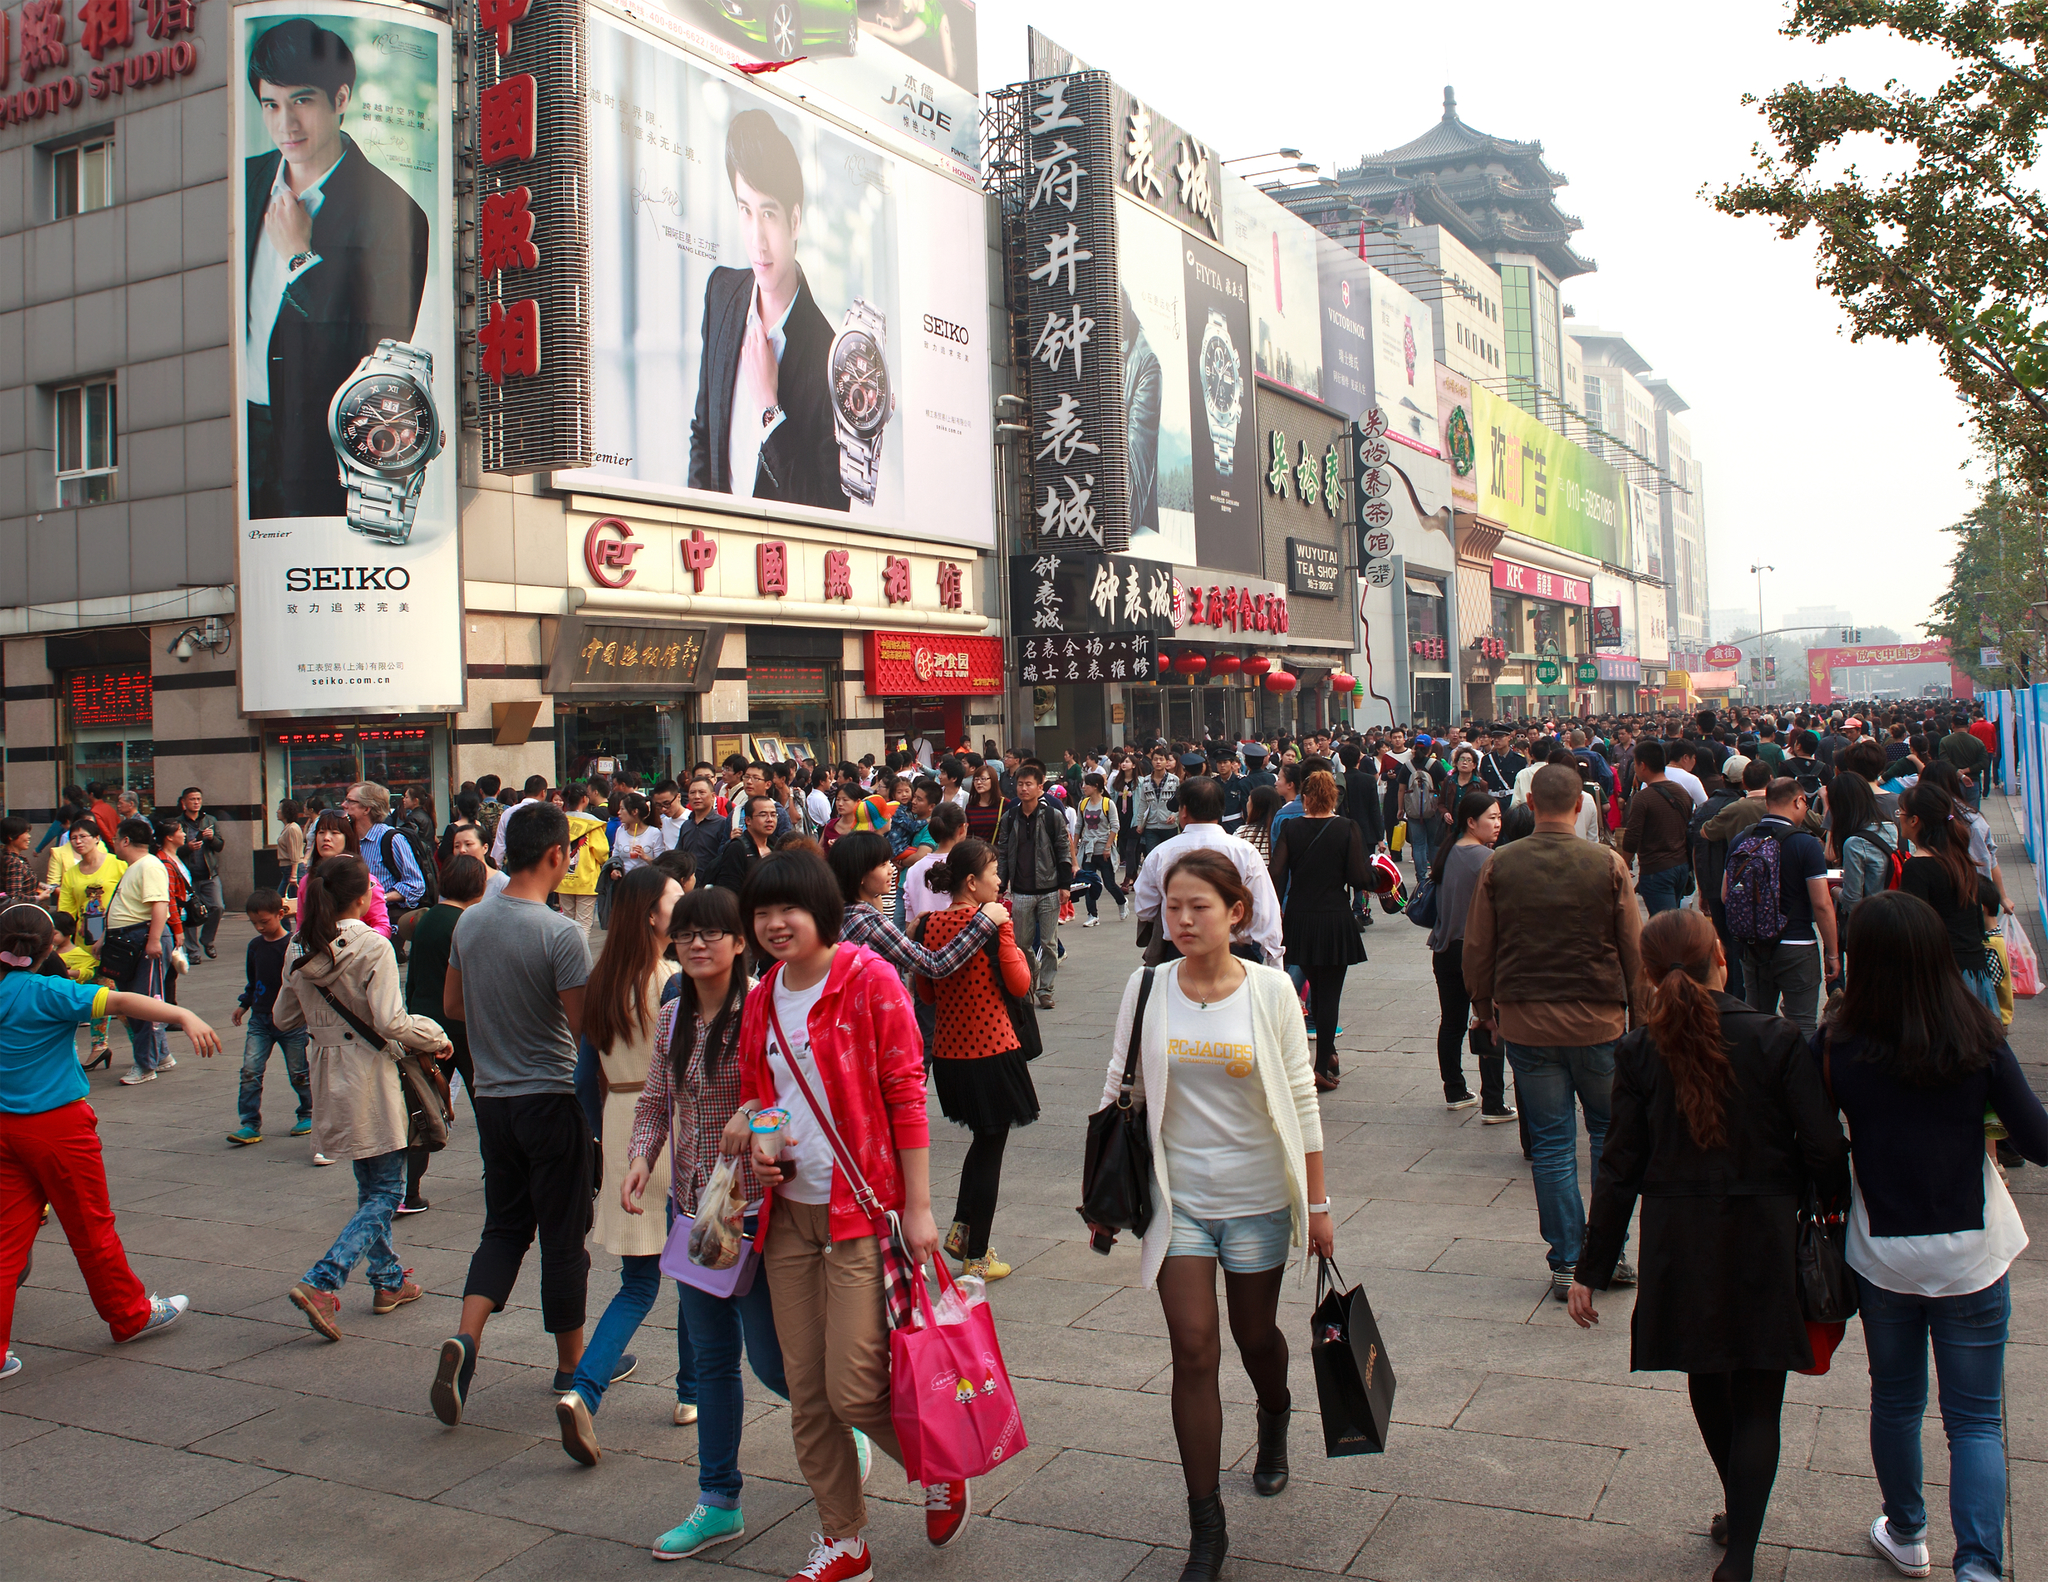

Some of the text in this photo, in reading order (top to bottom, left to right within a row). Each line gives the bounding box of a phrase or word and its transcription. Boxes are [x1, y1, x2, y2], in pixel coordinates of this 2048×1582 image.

[88, 41, 197, 101] STUDIO
[881, 85, 952, 133] JADE
[952, 166, 976, 184] HONDA
[676, 243, 717, 261] WANG LEEHOM
[1195, 261, 1223, 292] FIYTA
[1028, 81, 1104, 547] 王府井钟表城
[1328, 307, 1366, 340] VICTORINOX
[923, 313, 969, 346] SEIKO
[592, 452, 633, 467] emier
[1491, 426, 1547, 517] 欢颜广告
[1362, 409, 1390, 551] 吴裕泰茶馆
[248, 529, 293, 540] Premier
[1296, 544, 1338, 565] WUYUTAI
[286, 566, 411, 592] SEIKO
[1296, 561, 1338, 580] TEA SHOP
[1372, 574, 1389, 584] 2F
[1506, 564, 1577, 601] KFC 肯德基 KFC
[1030, 554, 1064, 632] 钟表城
[1090, 561, 1175, 627] 钟表城
[287, 602, 410, 615] 致力追求完美
[1023, 635, 1150, 659] 名表全场八折
[1856, 647, 1922, 663] 放飞中国梦
[297, 661, 404, 673] 精工表贸易(上海)有限公司
[933, 652, 969, 670] 御食园
[1023, 657, 1150, 682] 瑞士名表维修
[312, 676, 391, 686] seiko.com.cn
[1167, 1039, 1253, 1061] RCJACOBS
